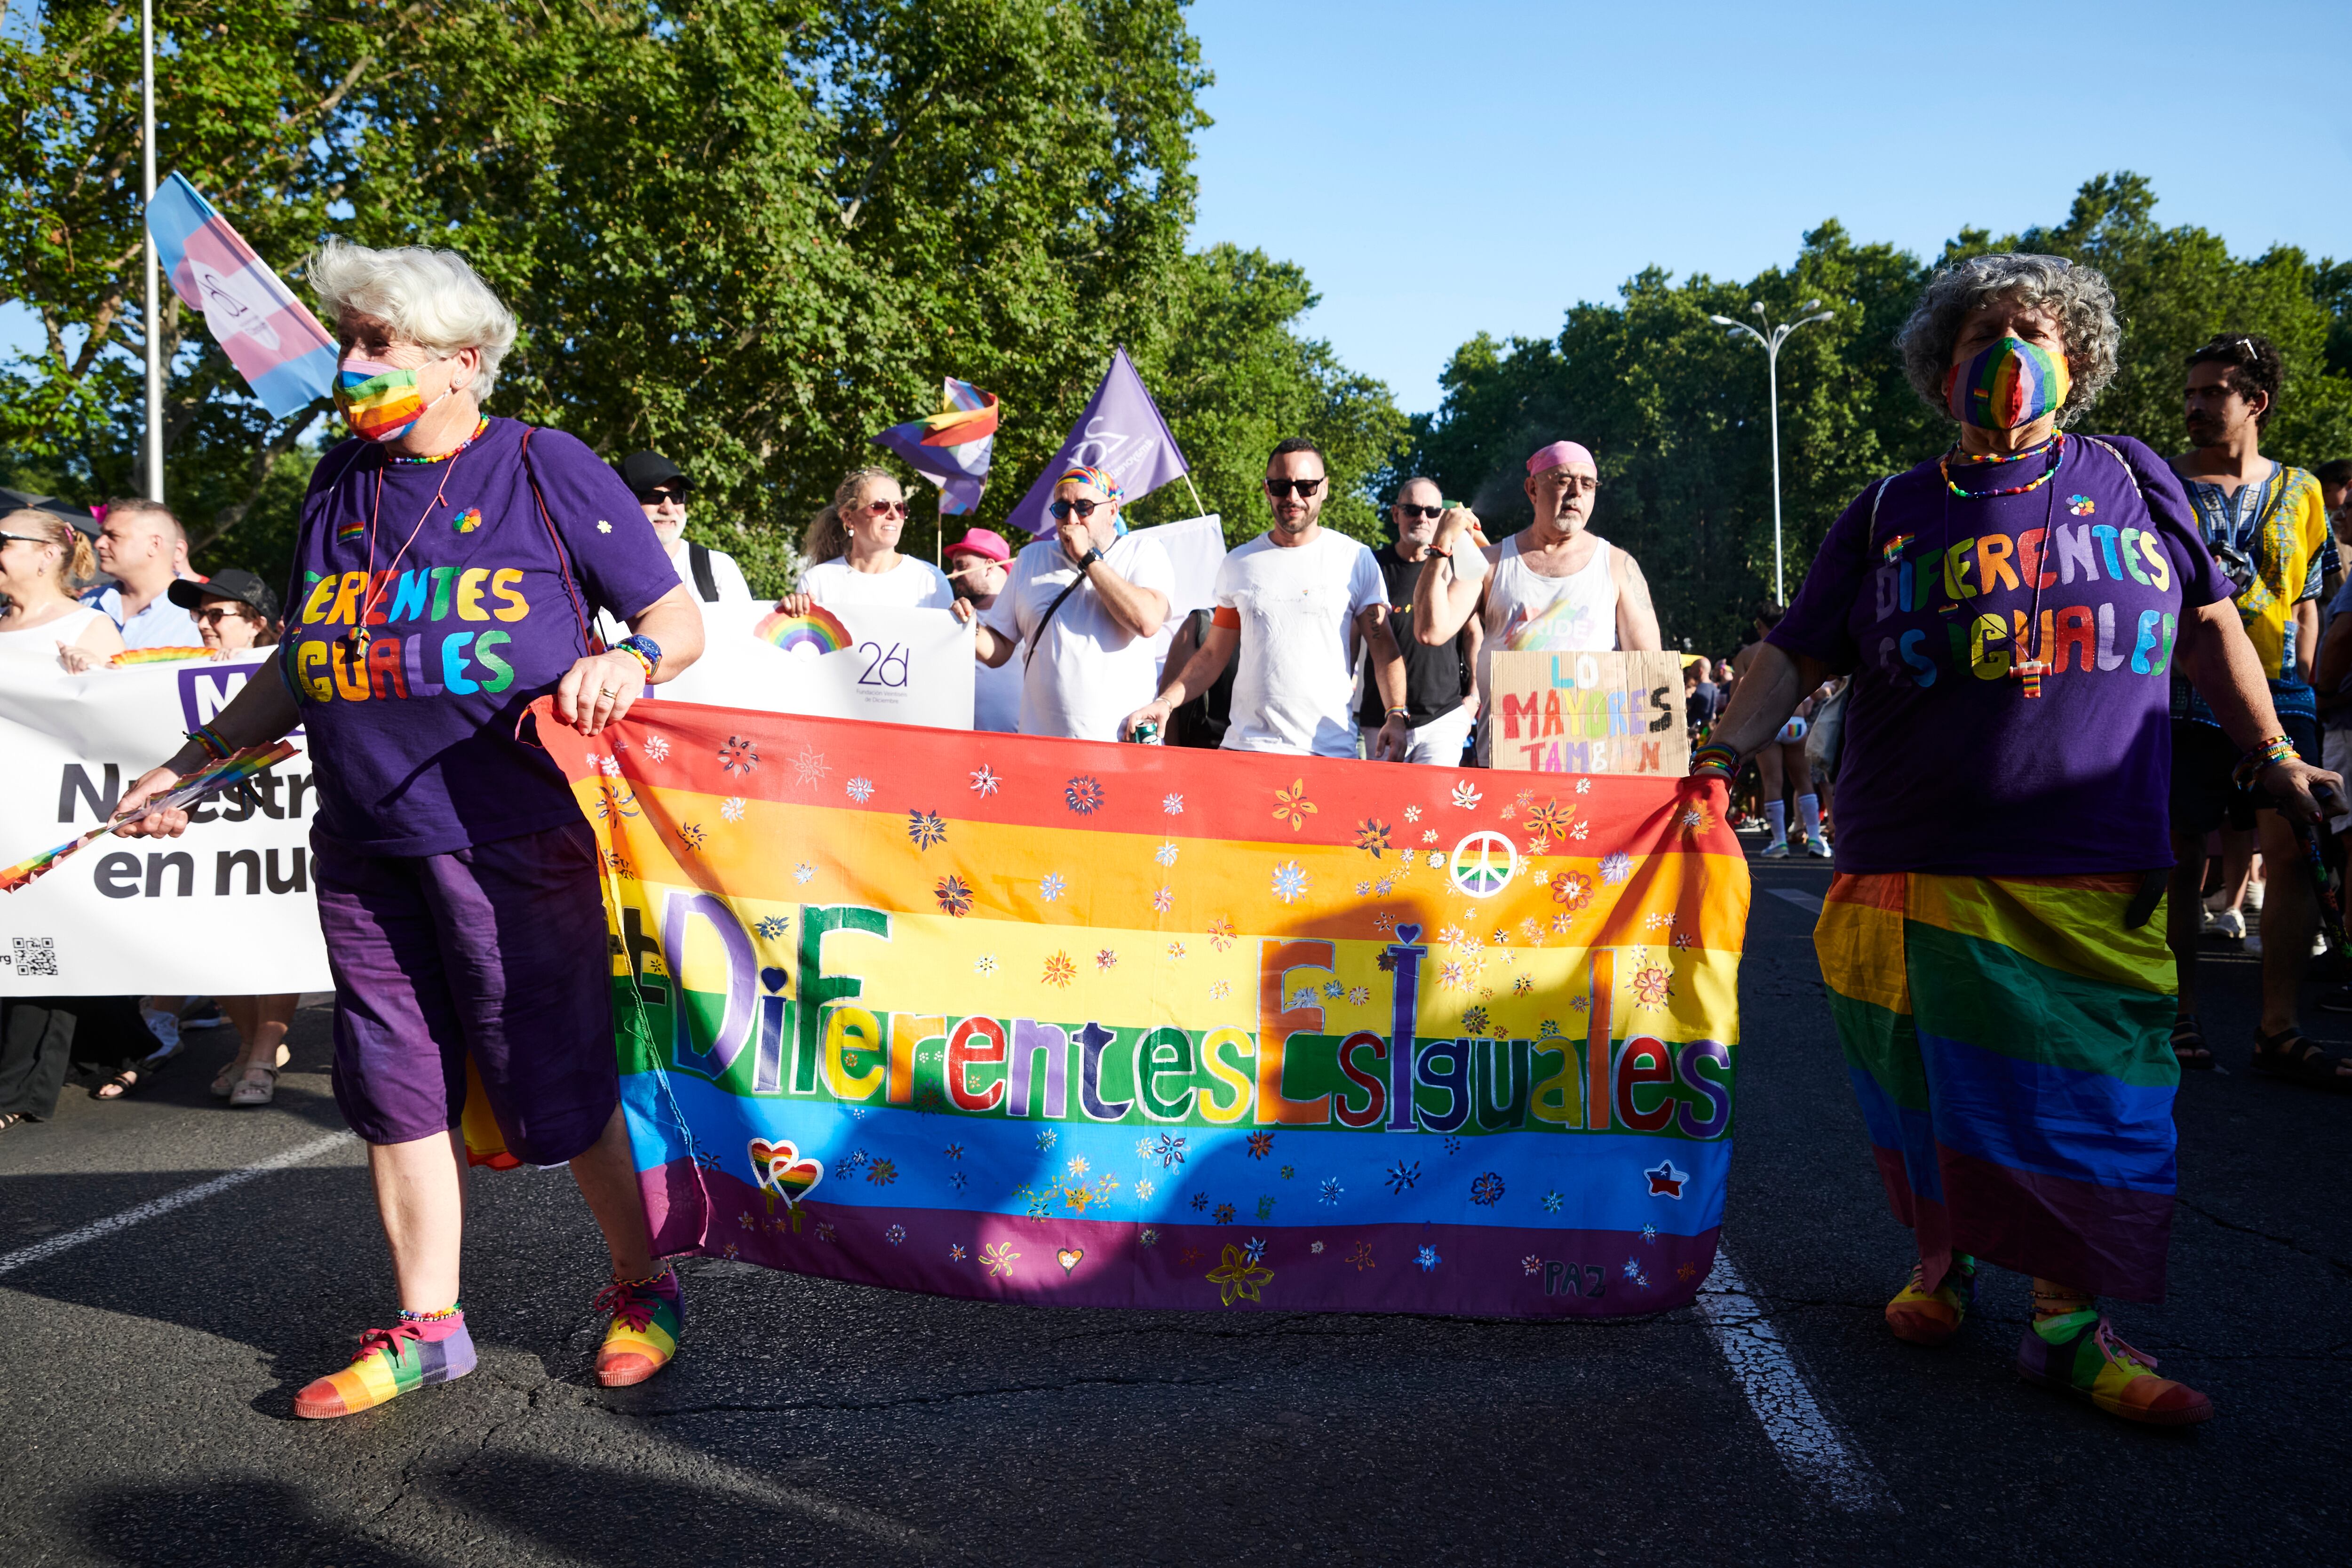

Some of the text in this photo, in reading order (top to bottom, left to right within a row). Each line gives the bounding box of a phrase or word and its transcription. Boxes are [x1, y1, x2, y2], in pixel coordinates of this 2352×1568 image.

[1876, 523, 2170, 622] DIFERENTES
[1947, 603, 2176, 681] IGUALES
[1502, 686, 1672, 740] MAYORES
[94, 847, 322, 899] en nu
[1544, 1260, 1607, 1298] PAZ
